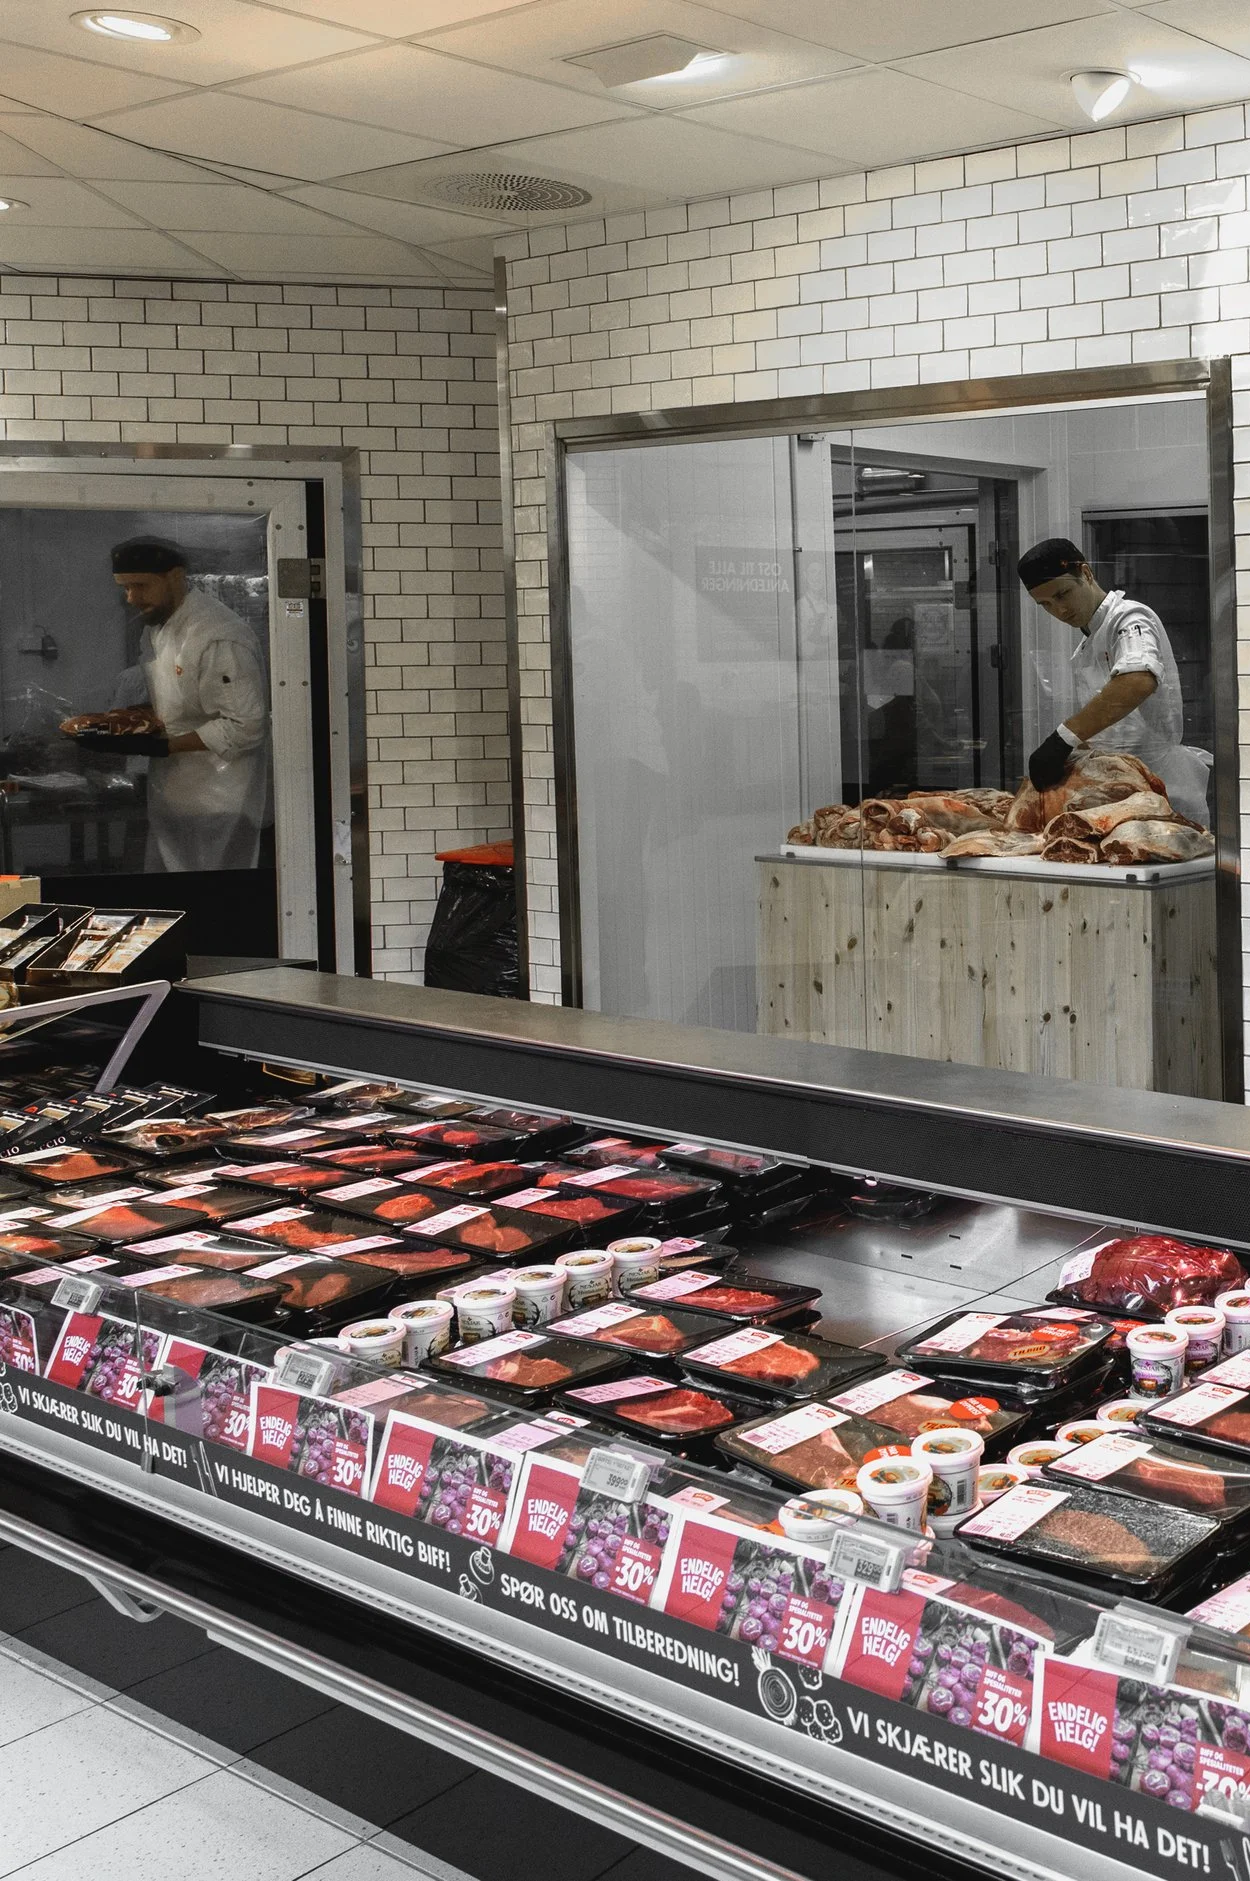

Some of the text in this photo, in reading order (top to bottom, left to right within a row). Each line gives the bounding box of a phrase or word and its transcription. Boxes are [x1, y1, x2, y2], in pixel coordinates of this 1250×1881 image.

[61, 1347, 84, 1366] HELG!
[64, 1334, 91, 1356] ENDELIG
[18, 1385, 188, 1468] VI SKJÆRER SLIK DU VIL HA DET!
[260, 1416, 292, 1437] ENDELIG
[262, 1429, 287, 1450] HELG!
[332, 1457, 362, 1486] -30%
[387, 1454, 424, 1479] ENDELIG
[388, 1471, 418, 1491] HELG!
[214, 1462, 451, 1573] VI HJELPER DEG Å FINNE RIKTIG BIFF!
[466, 1504, 501, 1537] -30%
[527, 1498, 568, 1526] ENDELIG
[528, 1516, 560, 1540] HELG!
[615, 1556, 656, 1592] -30%
[681, 1557, 725, 1586] ENDELIG
[682, 1575, 718, 1602] HELG!
[790, 1598, 802, 1607] BIFF
[788, 1605, 823, 1622] SPESIALITETER
[501, 1573, 740, 1687] SPØR OSS OM TILBEREDNING!
[783, 1617, 827, 1656] -30%
[861, 1616, 911, 1649] ENDELIG
[862, 1635, 902, 1667] HELG!
[983, 1677, 1022, 1698] SPESIALITETER
[985, 1668, 1006, 1683] BIFF OG
[976, 1690, 1028, 1732] -30%
[1048, 1701, 1108, 1734] ENDELIG
[1054, 1720, 1100, 1753] HELG!
[1199, 1756, 1245, 1777] SPESIALITETER
[1200, 1748, 1224, 1761] BIFF OG
[847, 1706, 1211, 1874] VI SKJÆRER SLIK DU VIL HA DET!
